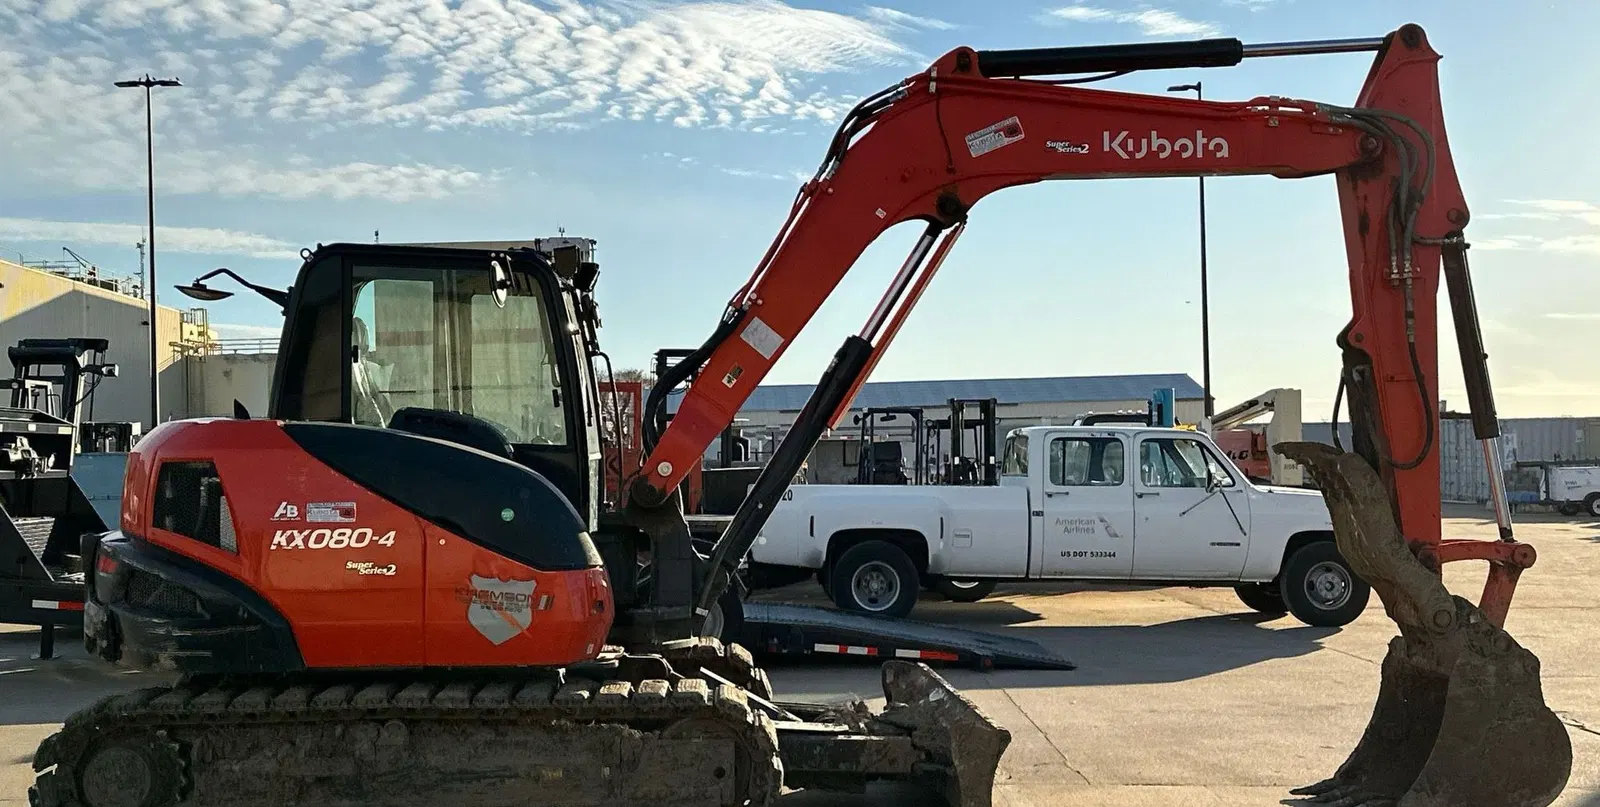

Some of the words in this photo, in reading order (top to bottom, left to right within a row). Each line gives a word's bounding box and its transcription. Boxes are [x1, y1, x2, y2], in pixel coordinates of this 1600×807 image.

[1045, 140, 1070, 149] Super
[1103, 130, 1229, 159] Kubota
[1055, 517, 1096, 526] American
[1063, 526, 1096, 535] Airlines
[270, 527, 397, 550] KX080-4
[1060, 550, 1071, 558] US
[1072, 550, 1088, 558] DOT
[345, 561, 375, 570] Super
